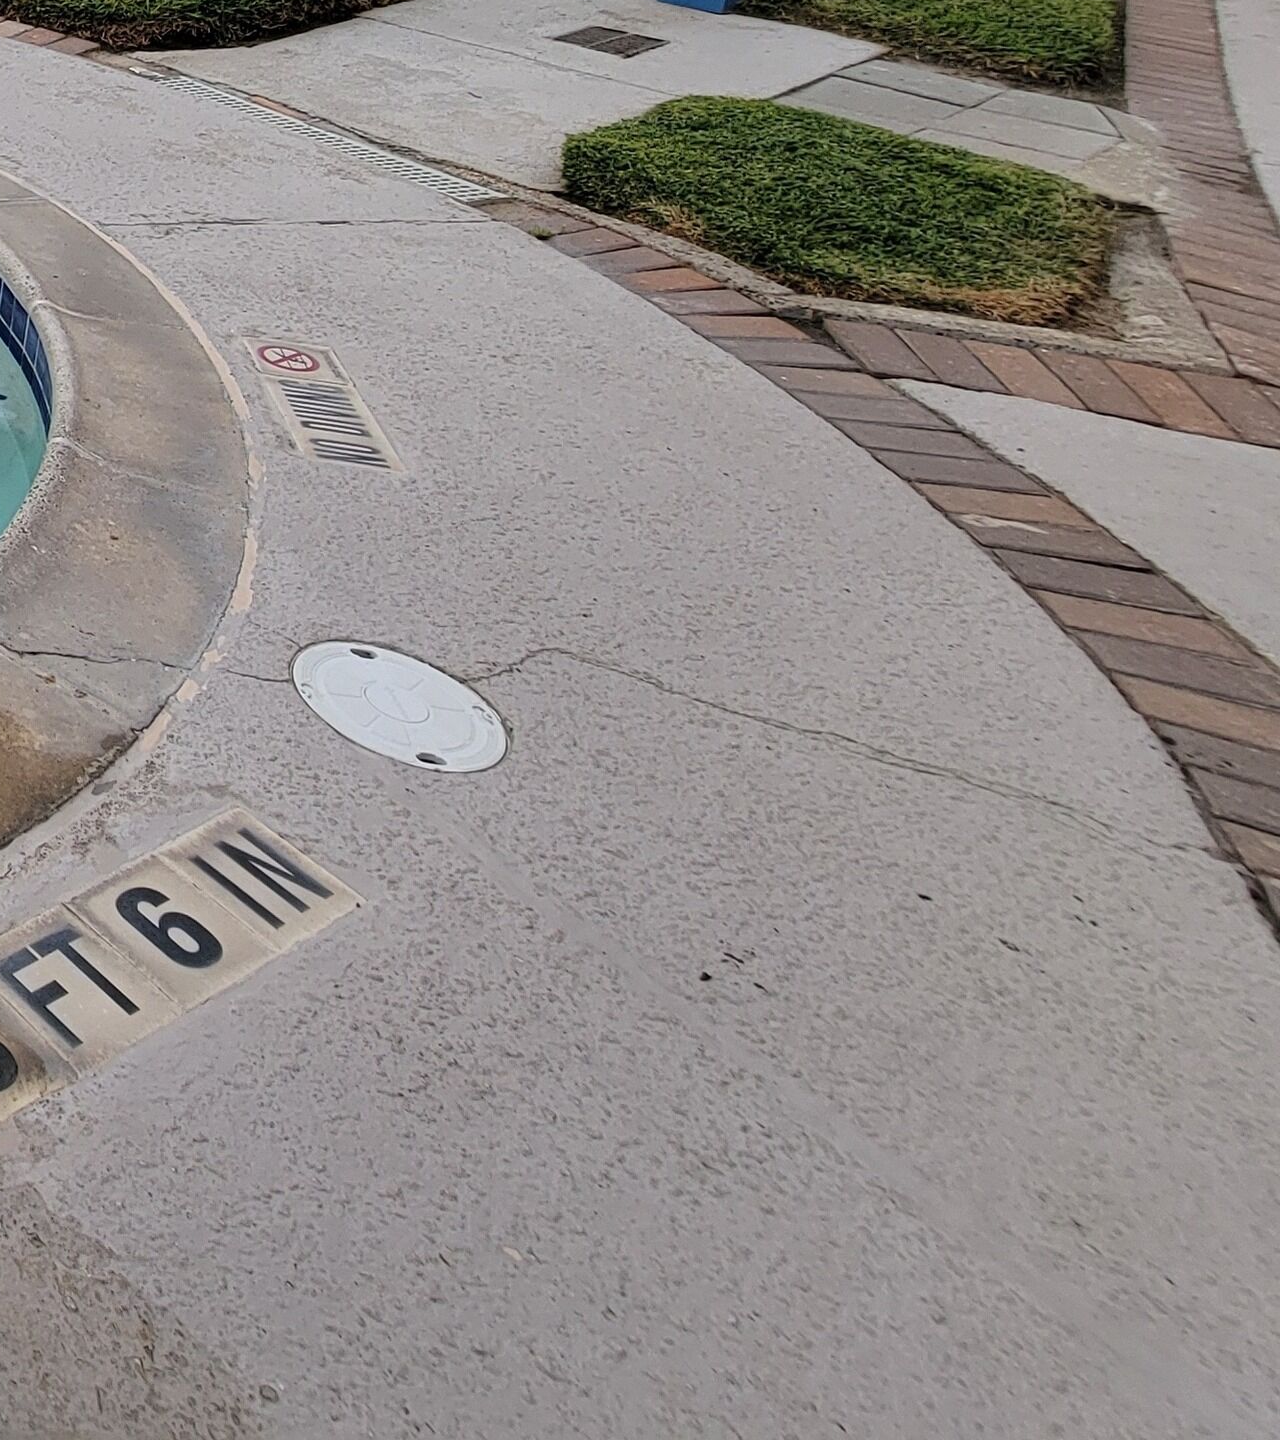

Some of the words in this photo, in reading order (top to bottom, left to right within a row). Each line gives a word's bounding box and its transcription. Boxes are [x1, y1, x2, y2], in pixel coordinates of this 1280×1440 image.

[278, 379, 373, 438] DIVING
[309, 438, 391, 469] NO
[115, 886, 224, 970] 6
[190, 827, 336, 931] IN
